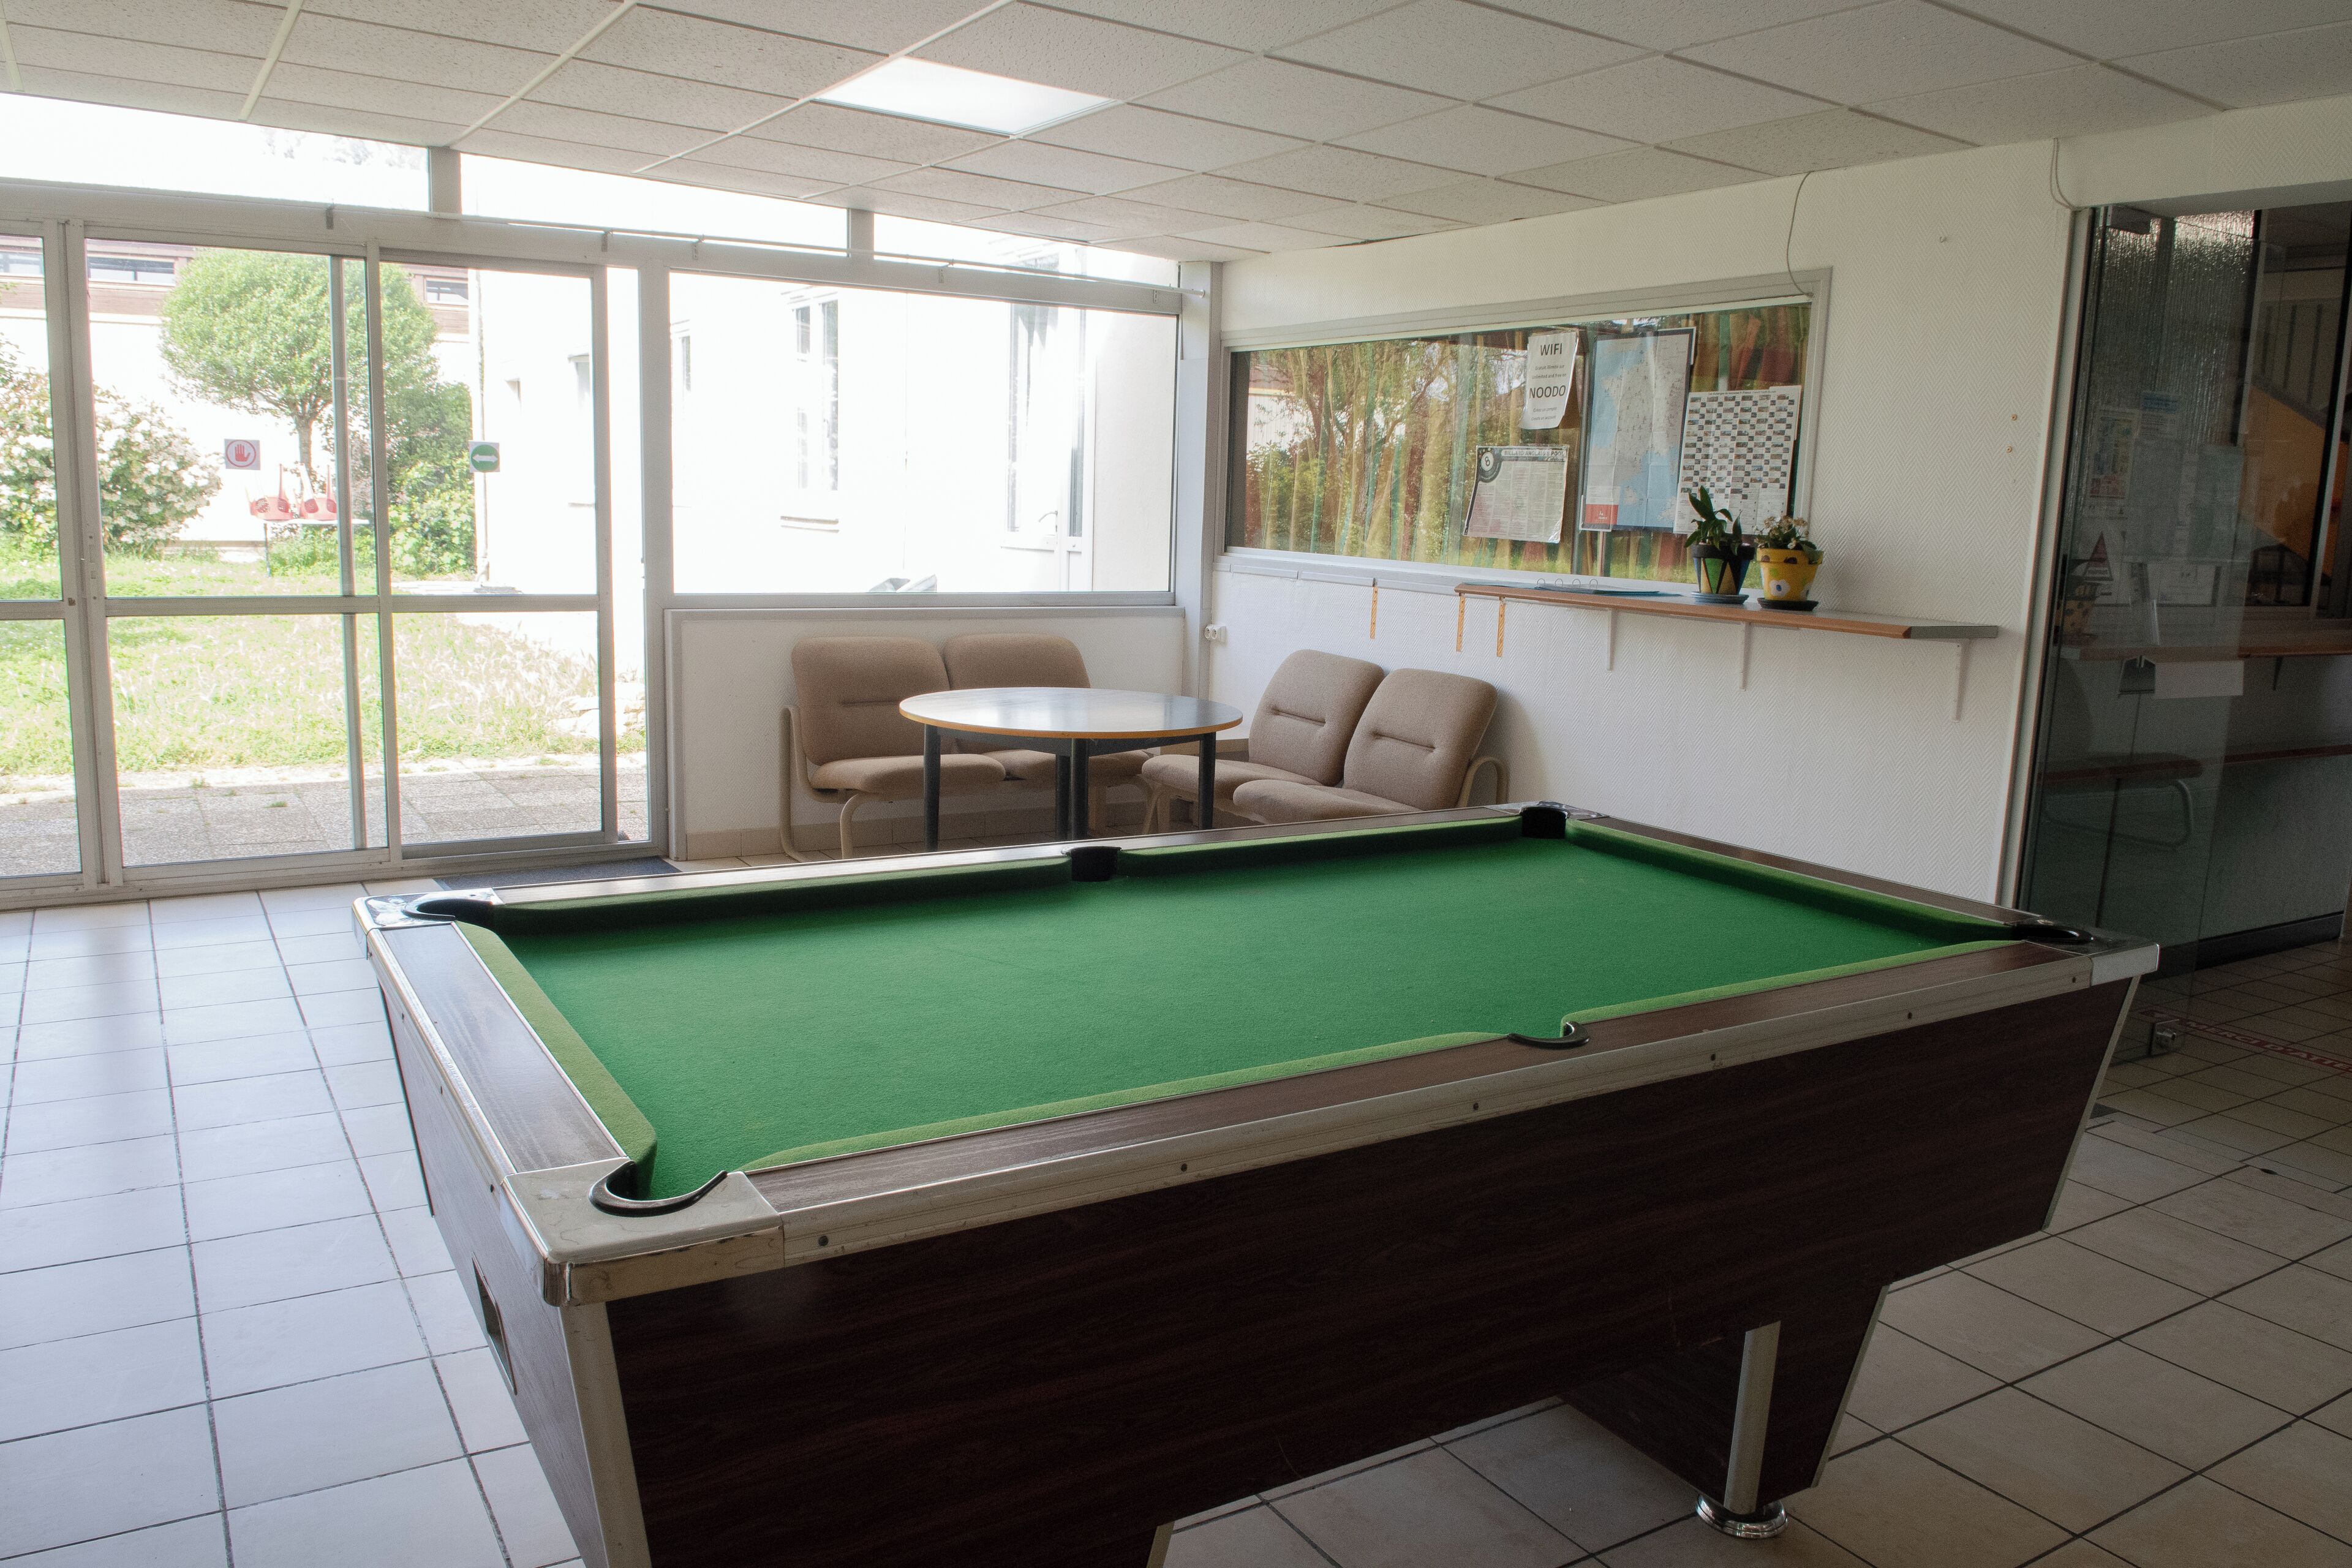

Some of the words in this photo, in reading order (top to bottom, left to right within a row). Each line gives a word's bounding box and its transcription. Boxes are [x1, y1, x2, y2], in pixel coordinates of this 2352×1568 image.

[1540, 343, 1562, 356] WIFI
[1529, 385, 1566, 399] NOODO
[1484, 456, 1490, 467] 8
[2185, 1019, 2261, 1046] MERCI
[2263, 1041, 2352, 1072] D'ATTE
